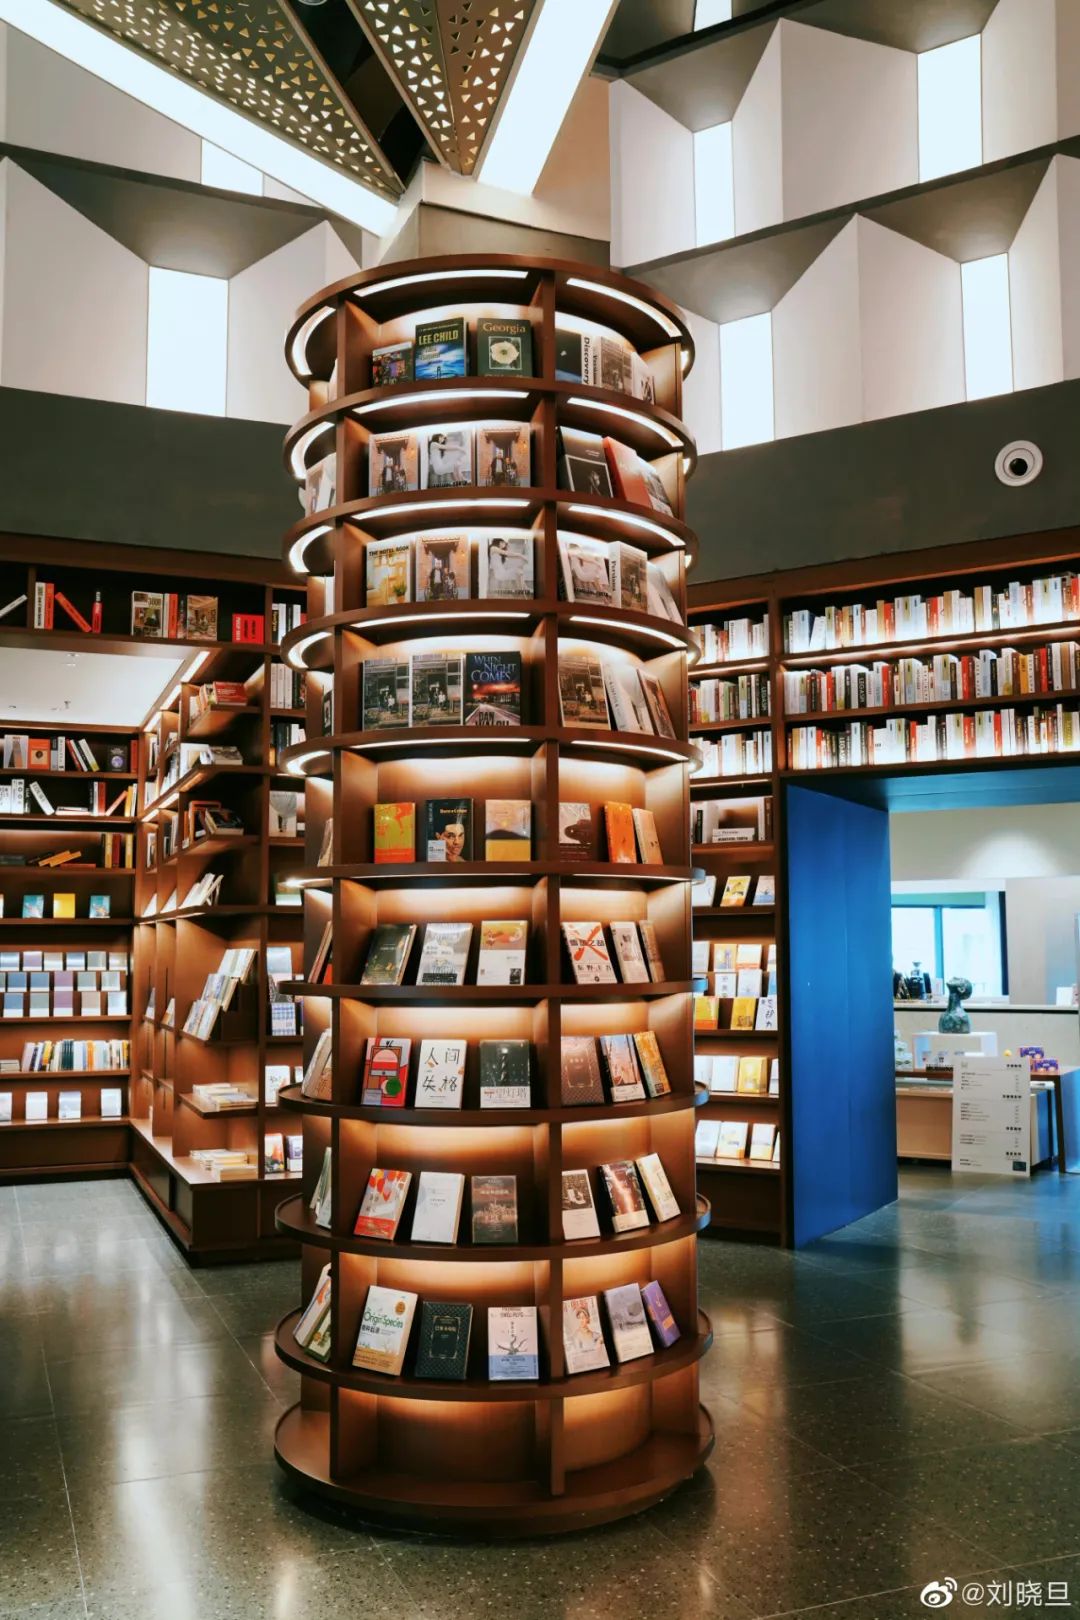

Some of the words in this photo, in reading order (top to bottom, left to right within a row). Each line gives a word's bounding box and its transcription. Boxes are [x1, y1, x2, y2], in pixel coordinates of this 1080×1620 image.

[483, 322, 526, 335] Georgia
[418, 334, 432, 346] LEE
[433, 329, 459, 343] CHILD
[474, 655, 502, 664] WHEN
[484, 663, 517, 673] NIGHT
[470, 669, 511, 682] COMES
[424, 1047, 461, 1065] 人间
[422, 1075, 458, 1092] 失格
